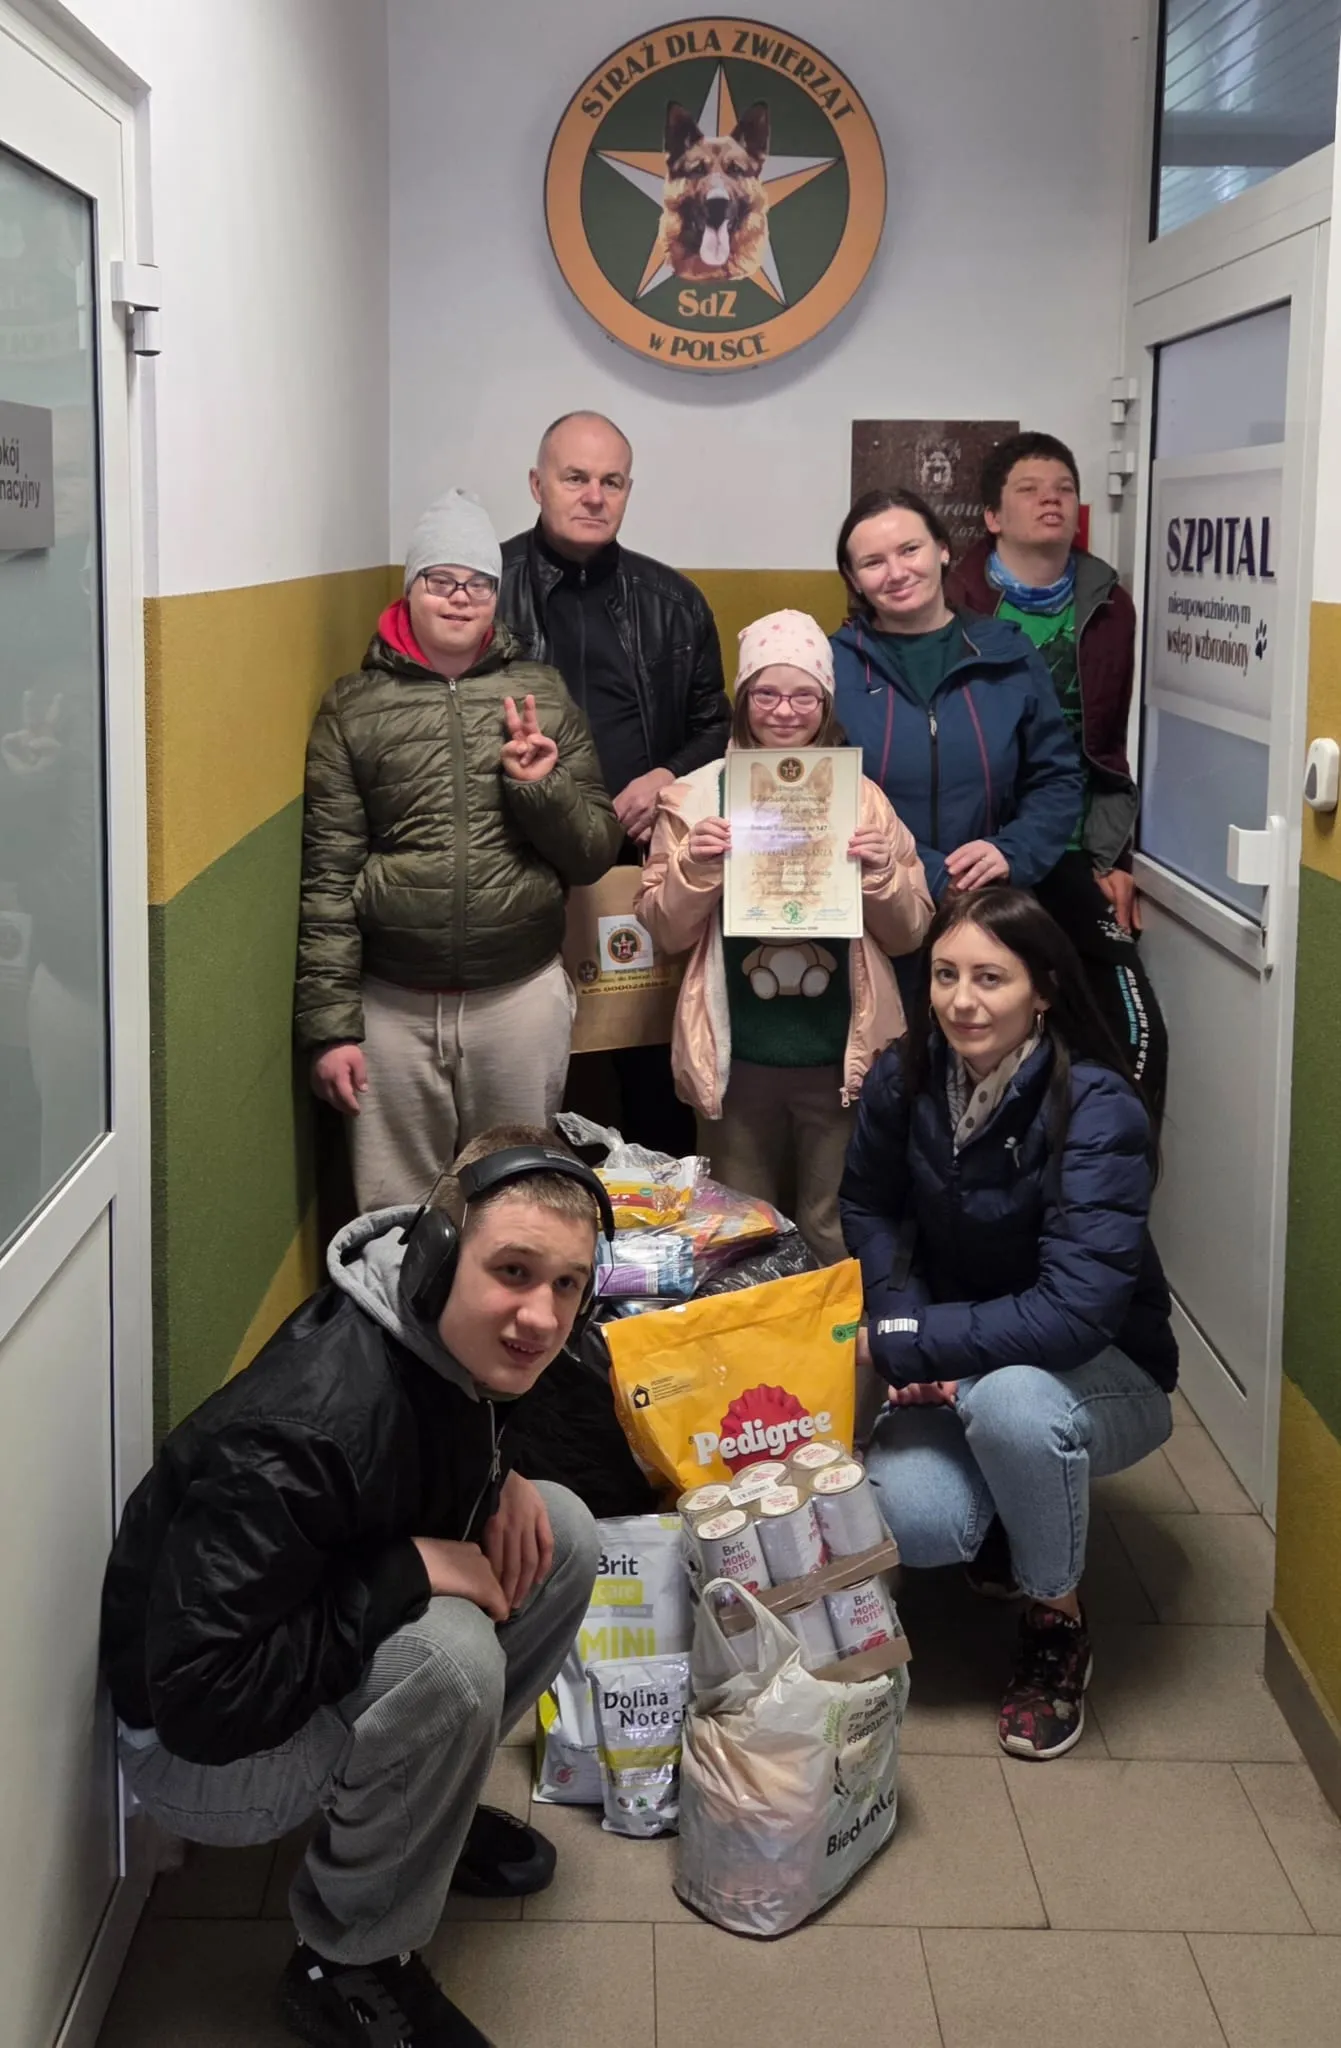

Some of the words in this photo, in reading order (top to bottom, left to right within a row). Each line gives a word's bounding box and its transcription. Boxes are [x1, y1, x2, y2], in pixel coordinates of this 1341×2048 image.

[665, 29, 722, 59] DLA
[678, 289, 738, 319] SdZ
[670, 332, 770, 362] POLSCE
[1166, 516, 1275, 578] SZPITAL
[1167, 624, 1193, 664] wstęp
[1194, 629, 1250, 677] wzbroniony
[877, 1317, 918, 1335] PUMA
[694, 1410, 833, 1465] Pedigree
[722, 1541, 745, 1556] Brit
[722, 1549, 751, 1567] MONO
[597, 1554, 639, 1576] Brit
[719, 1555, 757, 1576] PROTEIN
[853, 1591, 876, 1606] Brit
[853, 1599, 880, 1617] MONO
[849, 1606, 885, 1627] PROTEIN
[579, 1626, 656, 1663] MINI
[604, 1690, 669, 1709] Dolina
